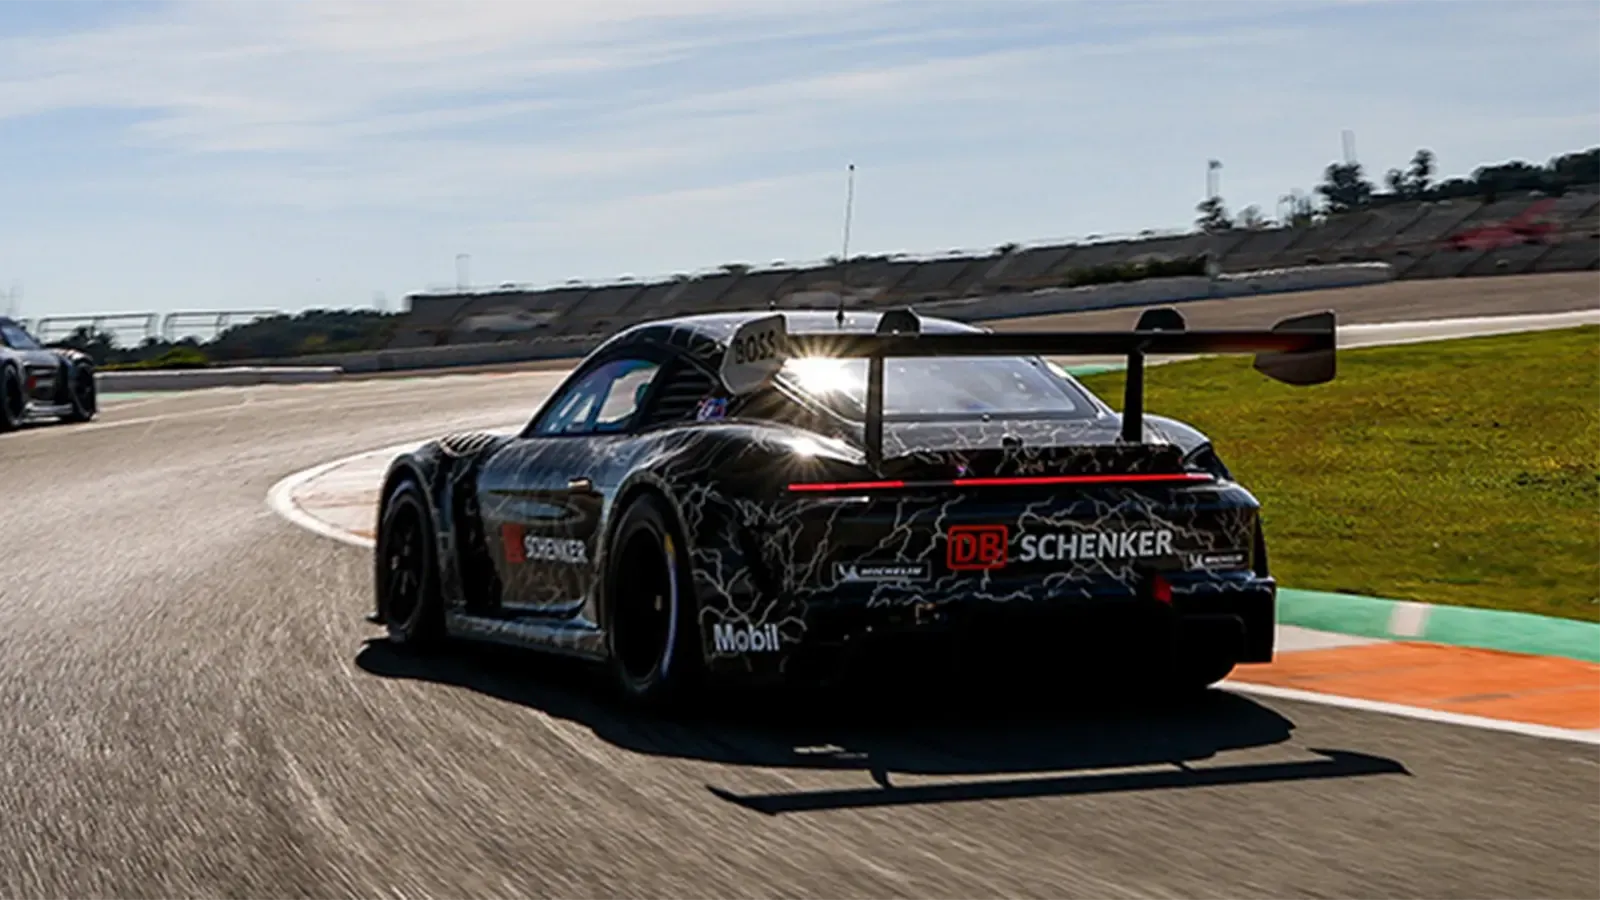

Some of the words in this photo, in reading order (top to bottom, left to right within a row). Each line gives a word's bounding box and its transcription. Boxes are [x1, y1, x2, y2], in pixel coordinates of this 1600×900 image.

[735, 329, 776, 364] BOSS
[954, 532, 1001, 563] DB
[1019, 529, 1174, 562] SCHENKER
[713, 623, 780, 652] Mobil
